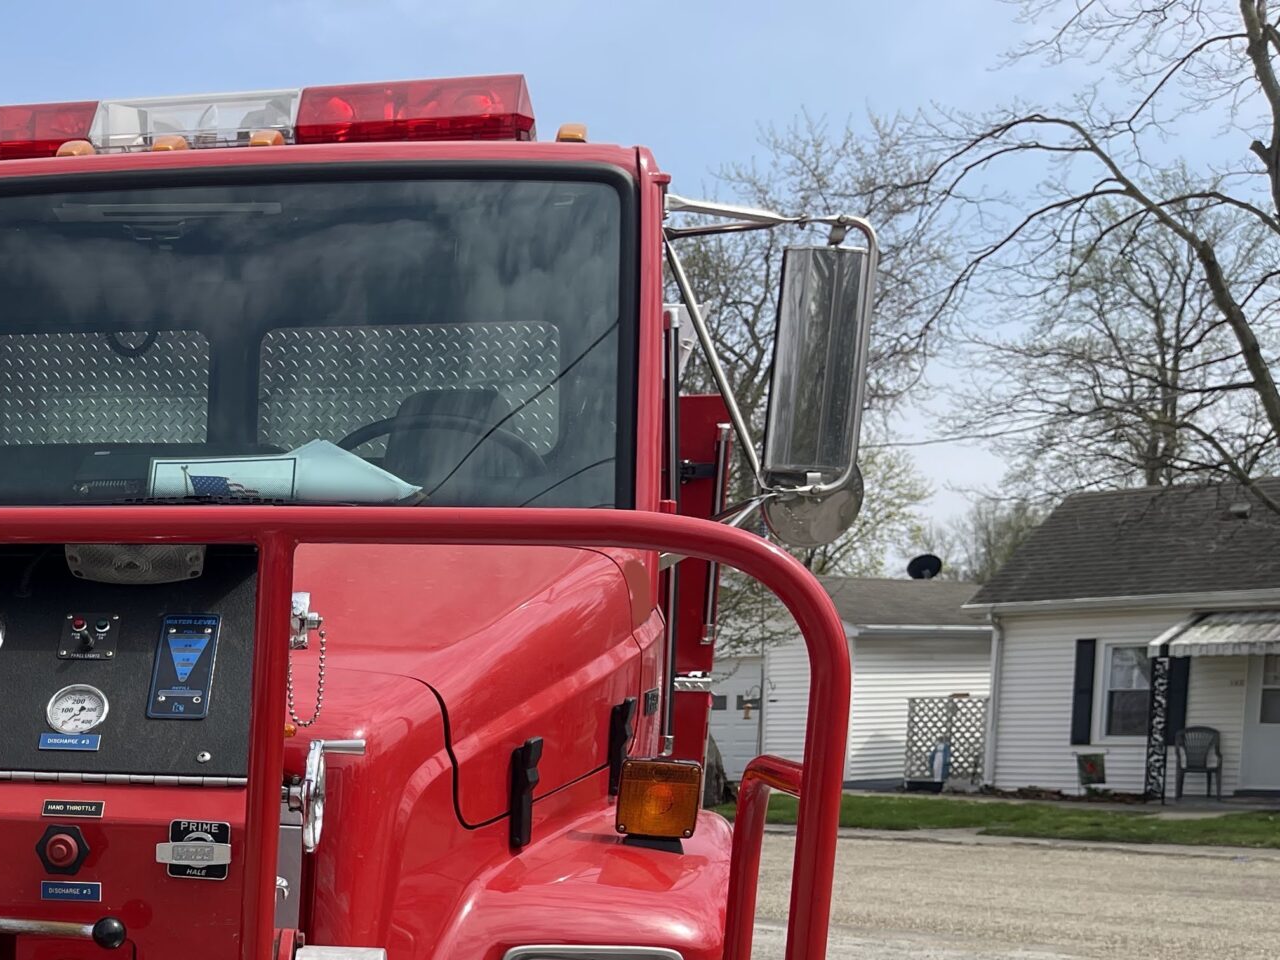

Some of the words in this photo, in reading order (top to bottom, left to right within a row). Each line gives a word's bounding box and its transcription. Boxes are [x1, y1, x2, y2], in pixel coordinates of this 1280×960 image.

[66, 804, 96, 812] THROTTLE
[181, 822, 220, 834] PRIME
[186, 868, 207, 876] HALE
